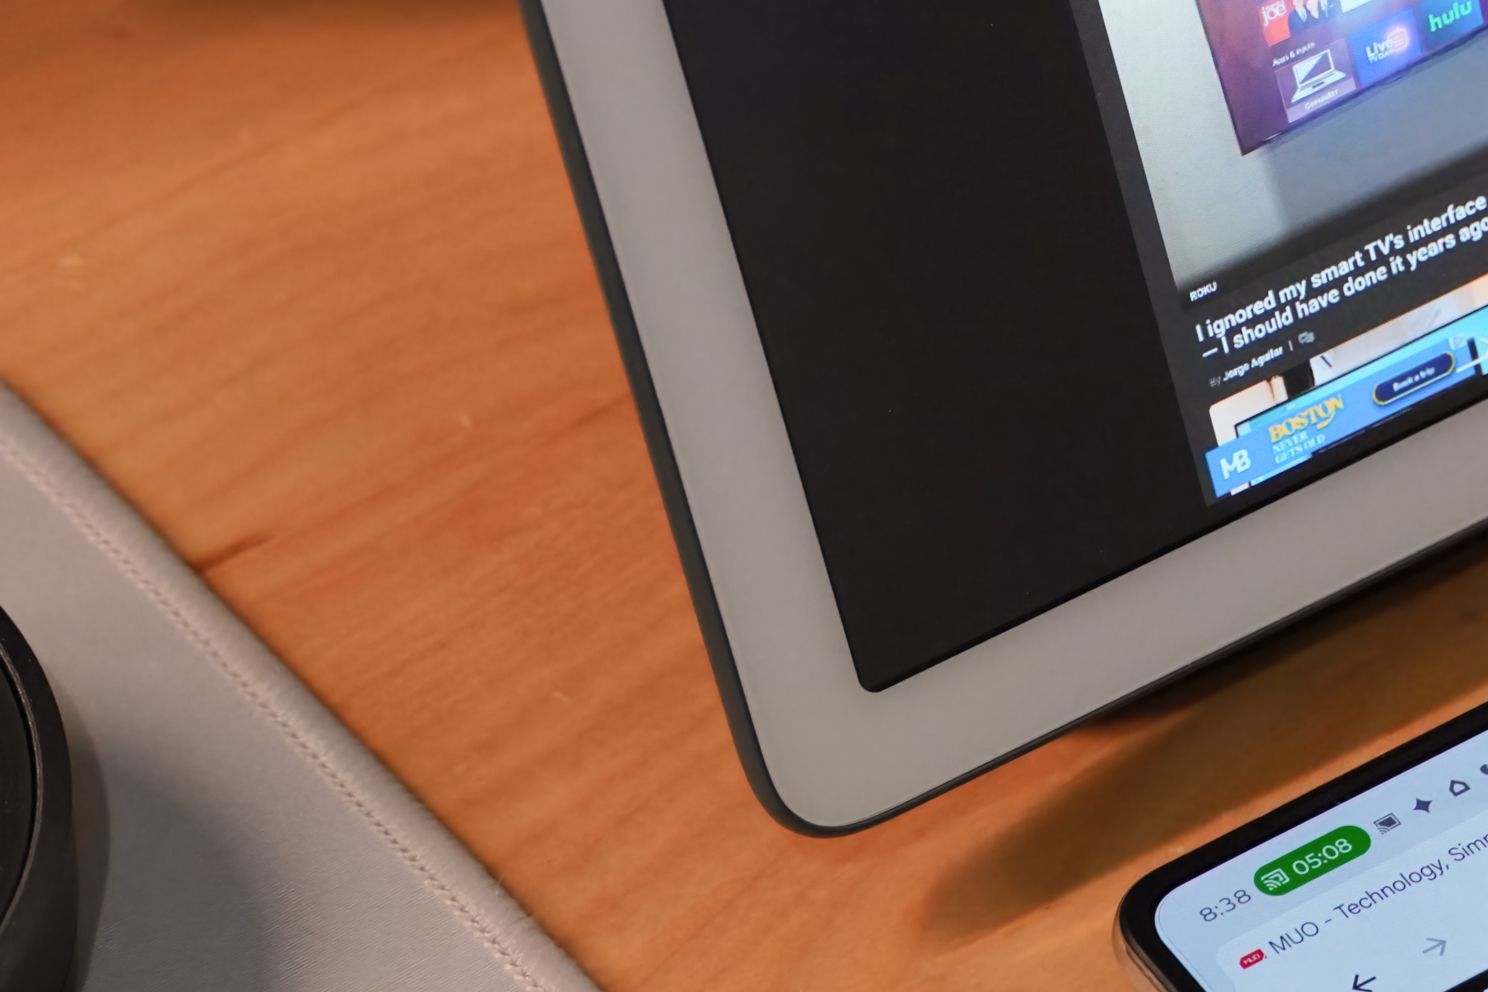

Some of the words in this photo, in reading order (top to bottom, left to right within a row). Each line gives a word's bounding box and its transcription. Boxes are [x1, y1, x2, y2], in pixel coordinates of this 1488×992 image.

[1428, 0, 1473, 32] hulu
[1195, 324, 1204, 342] I
[1205, 290, 1277, 338] ignored
[1279, 279, 1306, 300] my
[1311, 250, 1365, 288] smart
[1364, 233, 1405, 261] TV's
[1406, 195, 1487, 243] interface
[1189, 281, 1218, 302] ROKU
[1221, 336, 1229, 354] I
[1232, 305, 1294, 349] should
[1295, 288, 1340, 319] have
[1342, 265, 1388, 297] done
[1388, 255, 1405, 275] it
[1405, 233, 1457, 272] years
[1268, 394, 1345, 443] BOSTON
[1291, 837, 1353, 876] 05:08
[1199, 889, 1251, 923] 8:38
[1268, 921, 1319, 955] MUO
[1333, 859, 1450, 920] Technology,
